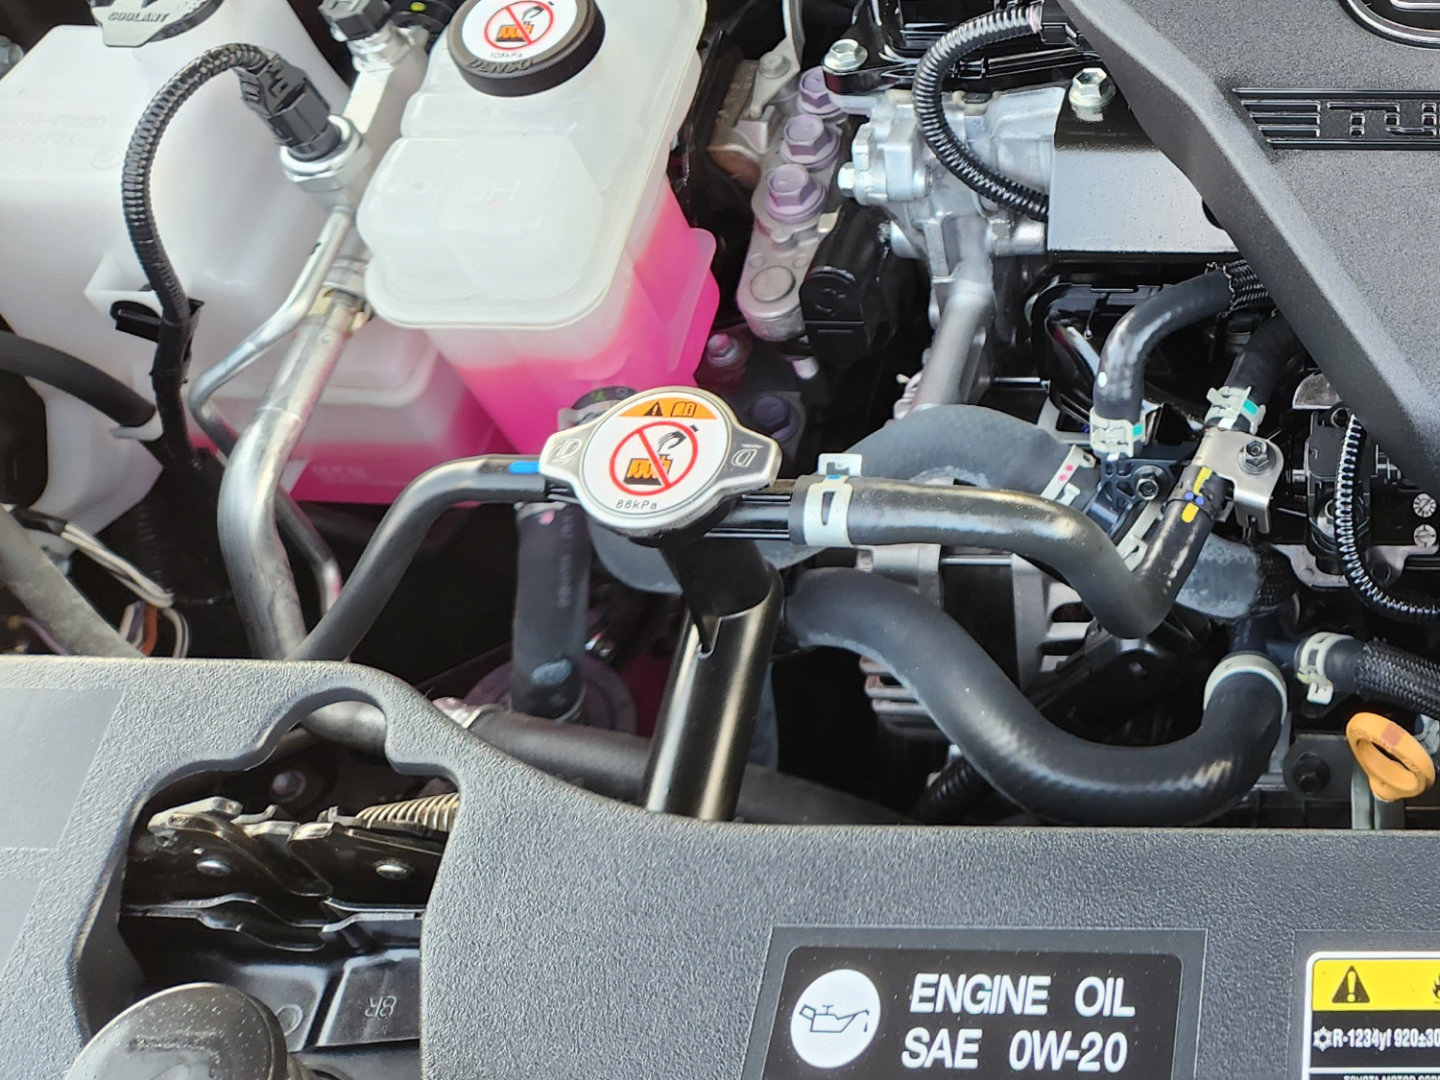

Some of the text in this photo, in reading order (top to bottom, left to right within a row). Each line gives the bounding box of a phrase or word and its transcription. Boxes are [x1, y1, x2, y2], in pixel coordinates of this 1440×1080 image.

[465, 58, 534, 73] DENSO
[615, 499, 658, 510] 88kPa
[910, 973, 1136, 1017] ENGINE OIL
[901, 1027, 1128, 1073] SAE 0W-20
[1332, 1028, 1392, 1051] R-1234yf
